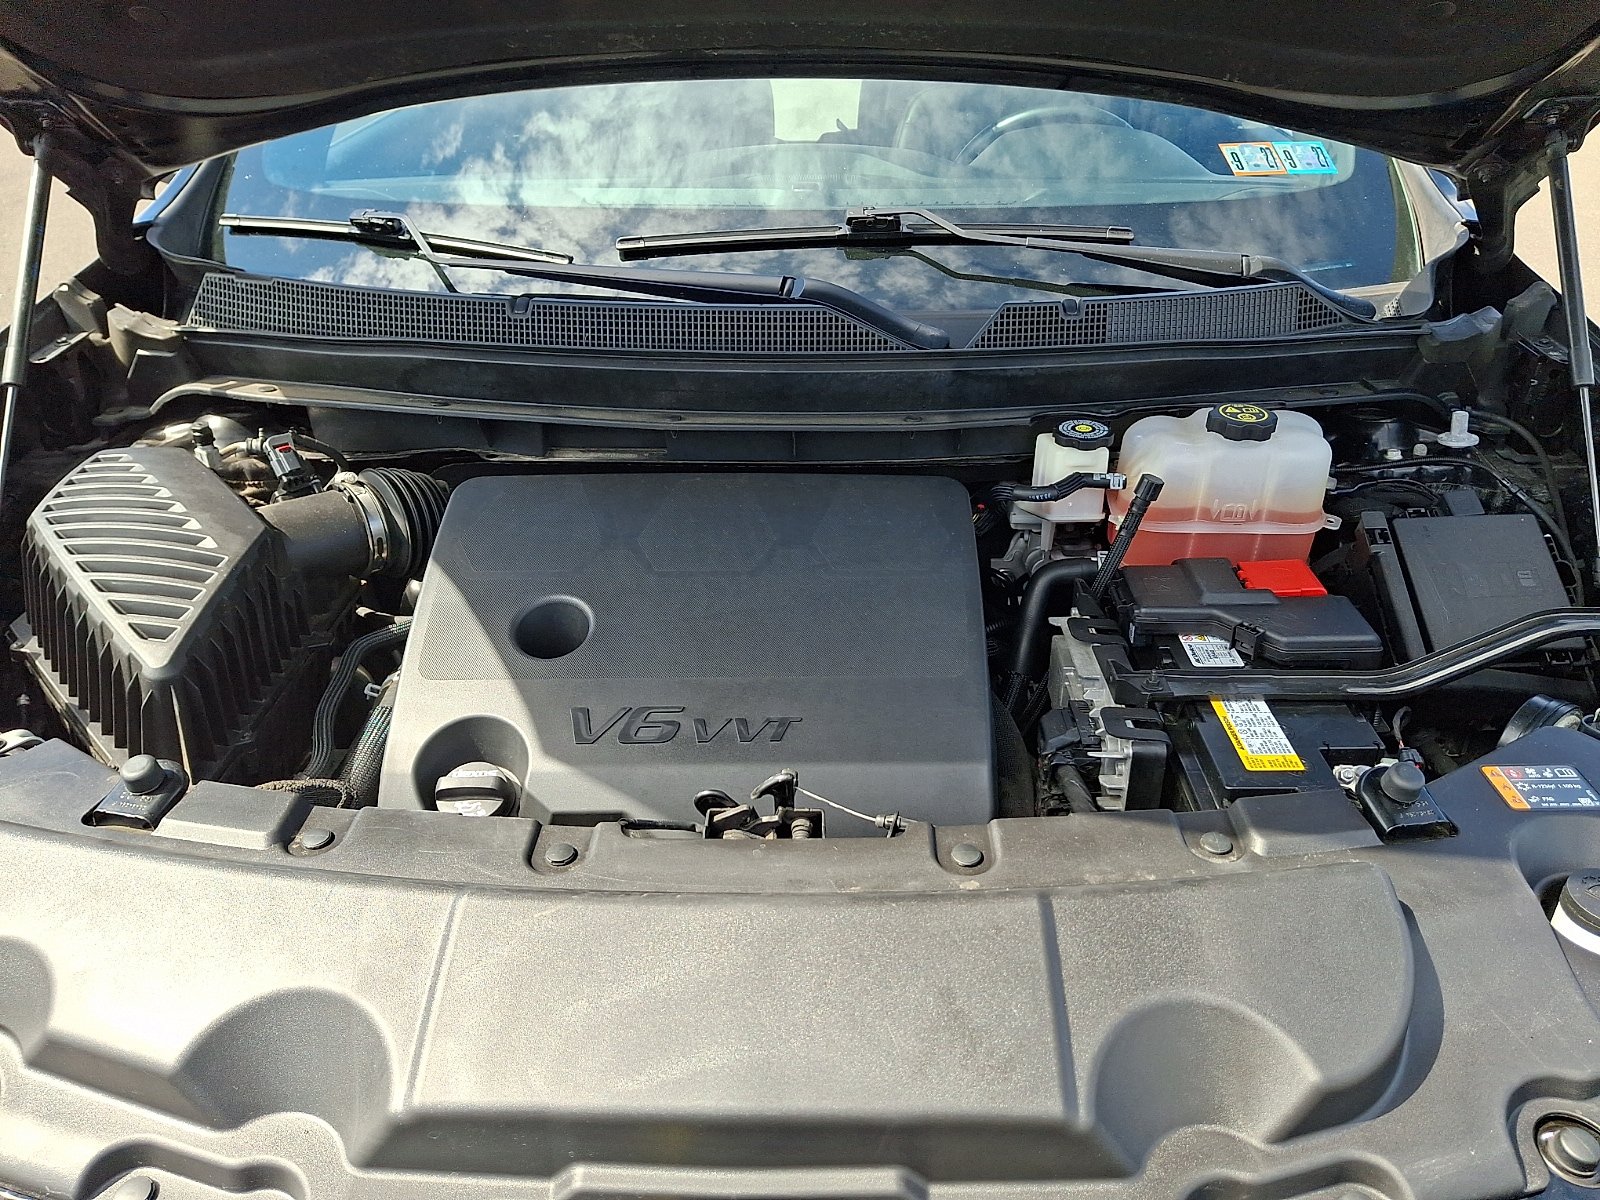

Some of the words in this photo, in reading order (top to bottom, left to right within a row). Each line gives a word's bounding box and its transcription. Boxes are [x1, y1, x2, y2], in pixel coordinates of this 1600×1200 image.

[1230, 151, 1245, 171] 9
[1260, 146, 1279, 170] 27
[1282, 149, 1298, 169] 9
[1310, 146, 1330, 168] 27
[570, 705, 686, 745] V6
[692, 716, 803, 744] VVT
